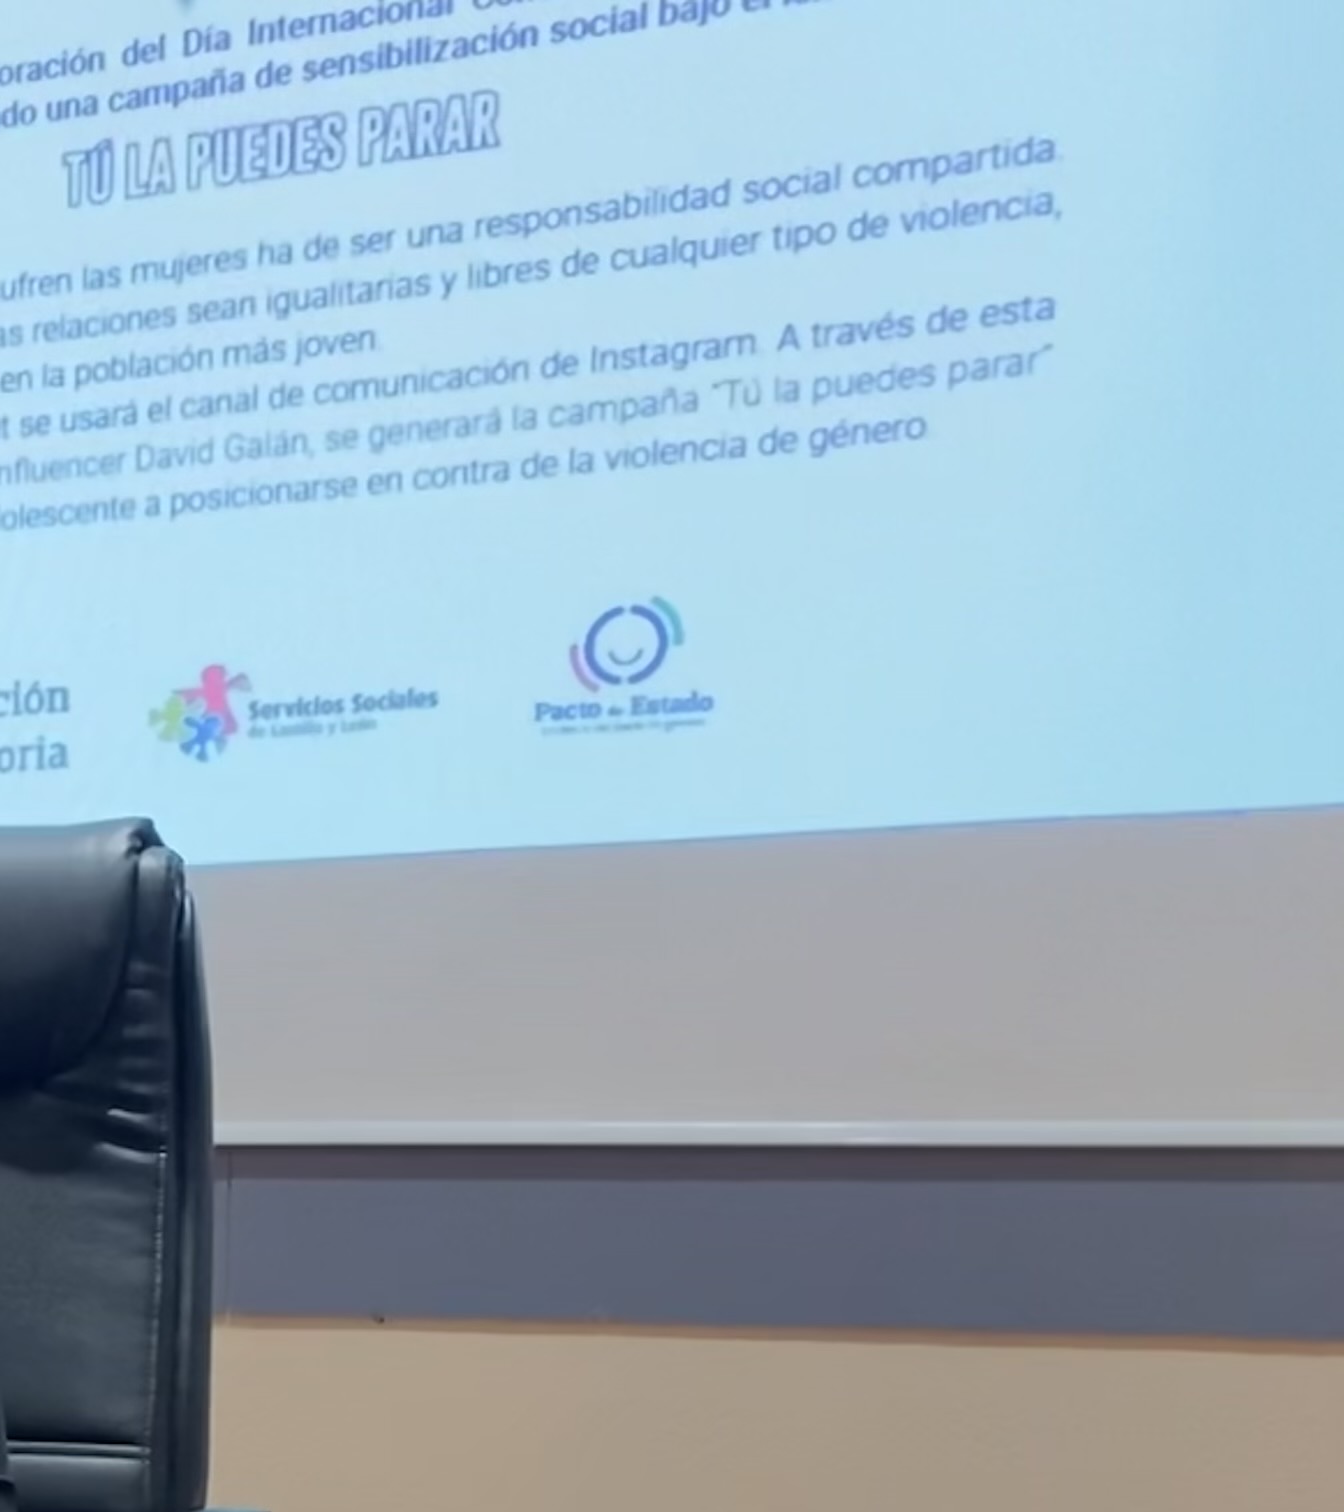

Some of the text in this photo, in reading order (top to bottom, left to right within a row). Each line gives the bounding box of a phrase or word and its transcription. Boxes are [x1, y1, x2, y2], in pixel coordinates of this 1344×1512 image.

[44, 93, 100, 124] una
[106, 68, 247, 114] campaña
[253, 58, 294, 91] de
[301, 23, 541, 82] sensibilización
[549, 0, 650, 46] social
[120, 31, 168, 69] del
[181, 23, 233, 59] Día
[59, 87, 504, 208] TÚ LA PUEDES PARAR
[31, 305, 178, 344] relaciones
[186, 294, 258, 326] sean
[265, 272, 433, 322] igualitarias
[439, 271, 459, 301] y
[466, 257, 552, 291] libres
[560, 247, 601, 279] de
[609, 230, 763, 273] cualquier
[771, 220, 838, 255] tipo
[846, 209, 891, 243] de
[899, 191, 1064, 235] violencia,
[81, 264, 123, 292] las
[129, 247, 249, 286] mujeres
[256, 239, 295, 268] ha
[302, 232, 341, 263] de
[349, 228, 397, 258] ser
[406, 220, 465, 250] una
[473, 180, 733, 240] responsabilidad
[741, 162, 843, 206] social
[18, 413, 53, 440] se
[58, 398, 139, 435] usará
[146, 394, 173, 425] el
[179, 383, 260, 421] canal
[267, 381, 305, 412] de
[312, 356, 531, 406] comunicación
[539, 349, 581, 381] de
[775, 322, 802, 353] A
[810, 310, 916, 350] través
[924, 303, 970, 337] de
[978, 295, 1059, 329] esta
[41, 362, 67, 390] la
[73, 346, 215, 389] población
[221, 335, 288, 369] más
[248, 686, 439, 722] Servicios Sociales
[534, 700, 603, 722] Pacto
[629, 690, 715, 717] Estado
